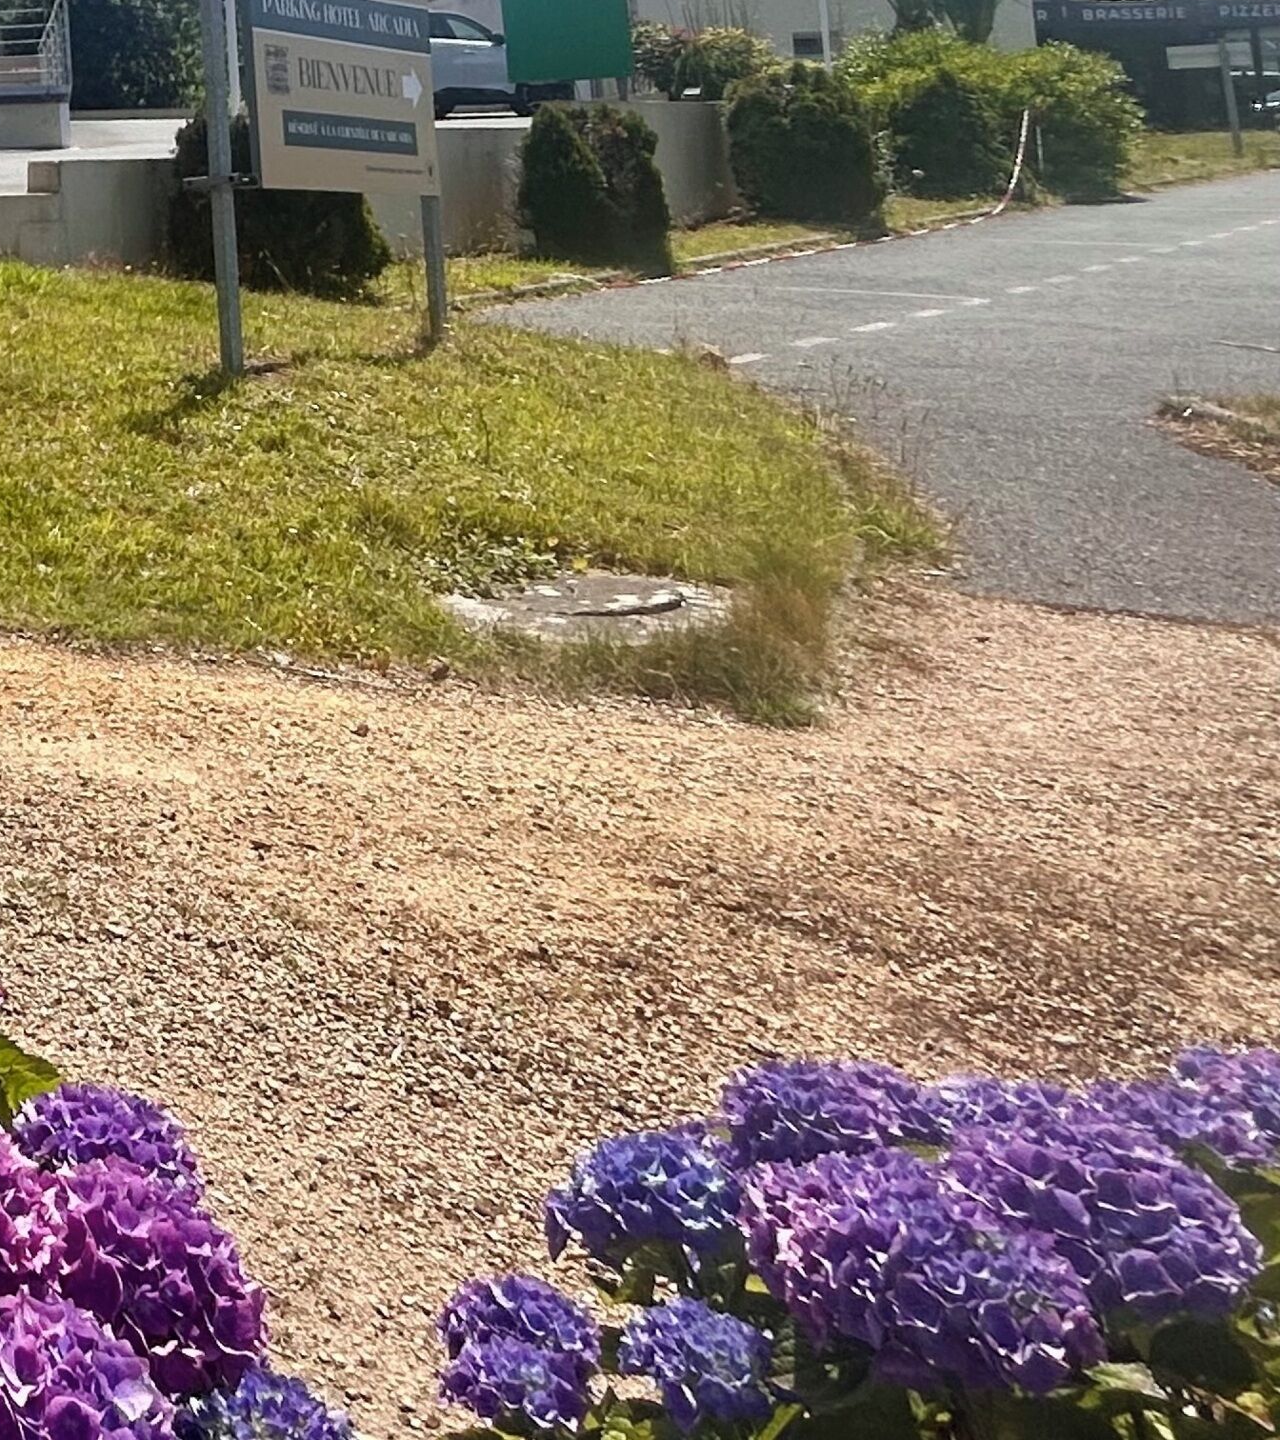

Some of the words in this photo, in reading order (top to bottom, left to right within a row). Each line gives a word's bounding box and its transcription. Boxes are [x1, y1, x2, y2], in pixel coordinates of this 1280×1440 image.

[322, 3, 361, 29] HOTEL
[368, 12, 420, 38] ARCADIA
[1082, 6, 1187, 21] BRASSERIE
[298, 57, 399, 98] BIENVENUE
